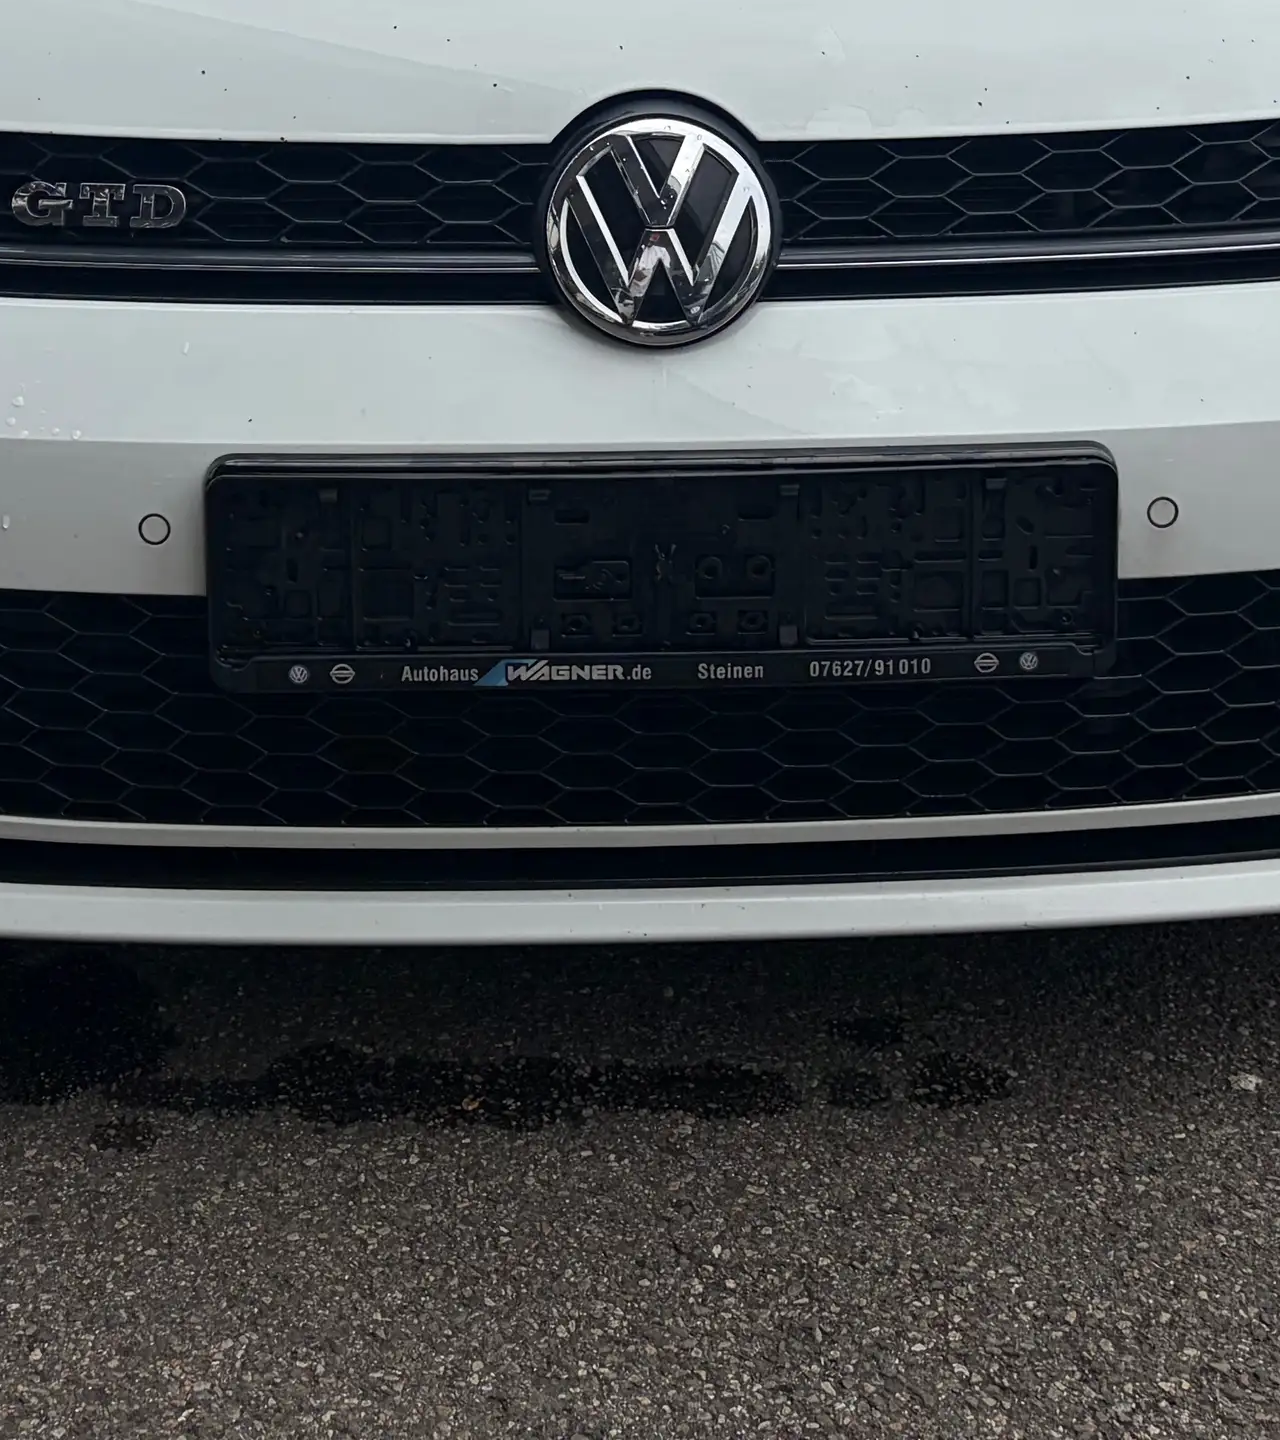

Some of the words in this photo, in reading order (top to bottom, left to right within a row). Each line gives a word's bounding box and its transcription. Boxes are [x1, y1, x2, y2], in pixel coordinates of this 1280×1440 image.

[11, 180, 187, 229] GTD
[401, 665, 479, 683] Autohaus
[507, 660, 652, 682] WAGNER.de
[697, 662, 765, 679] Steinen
